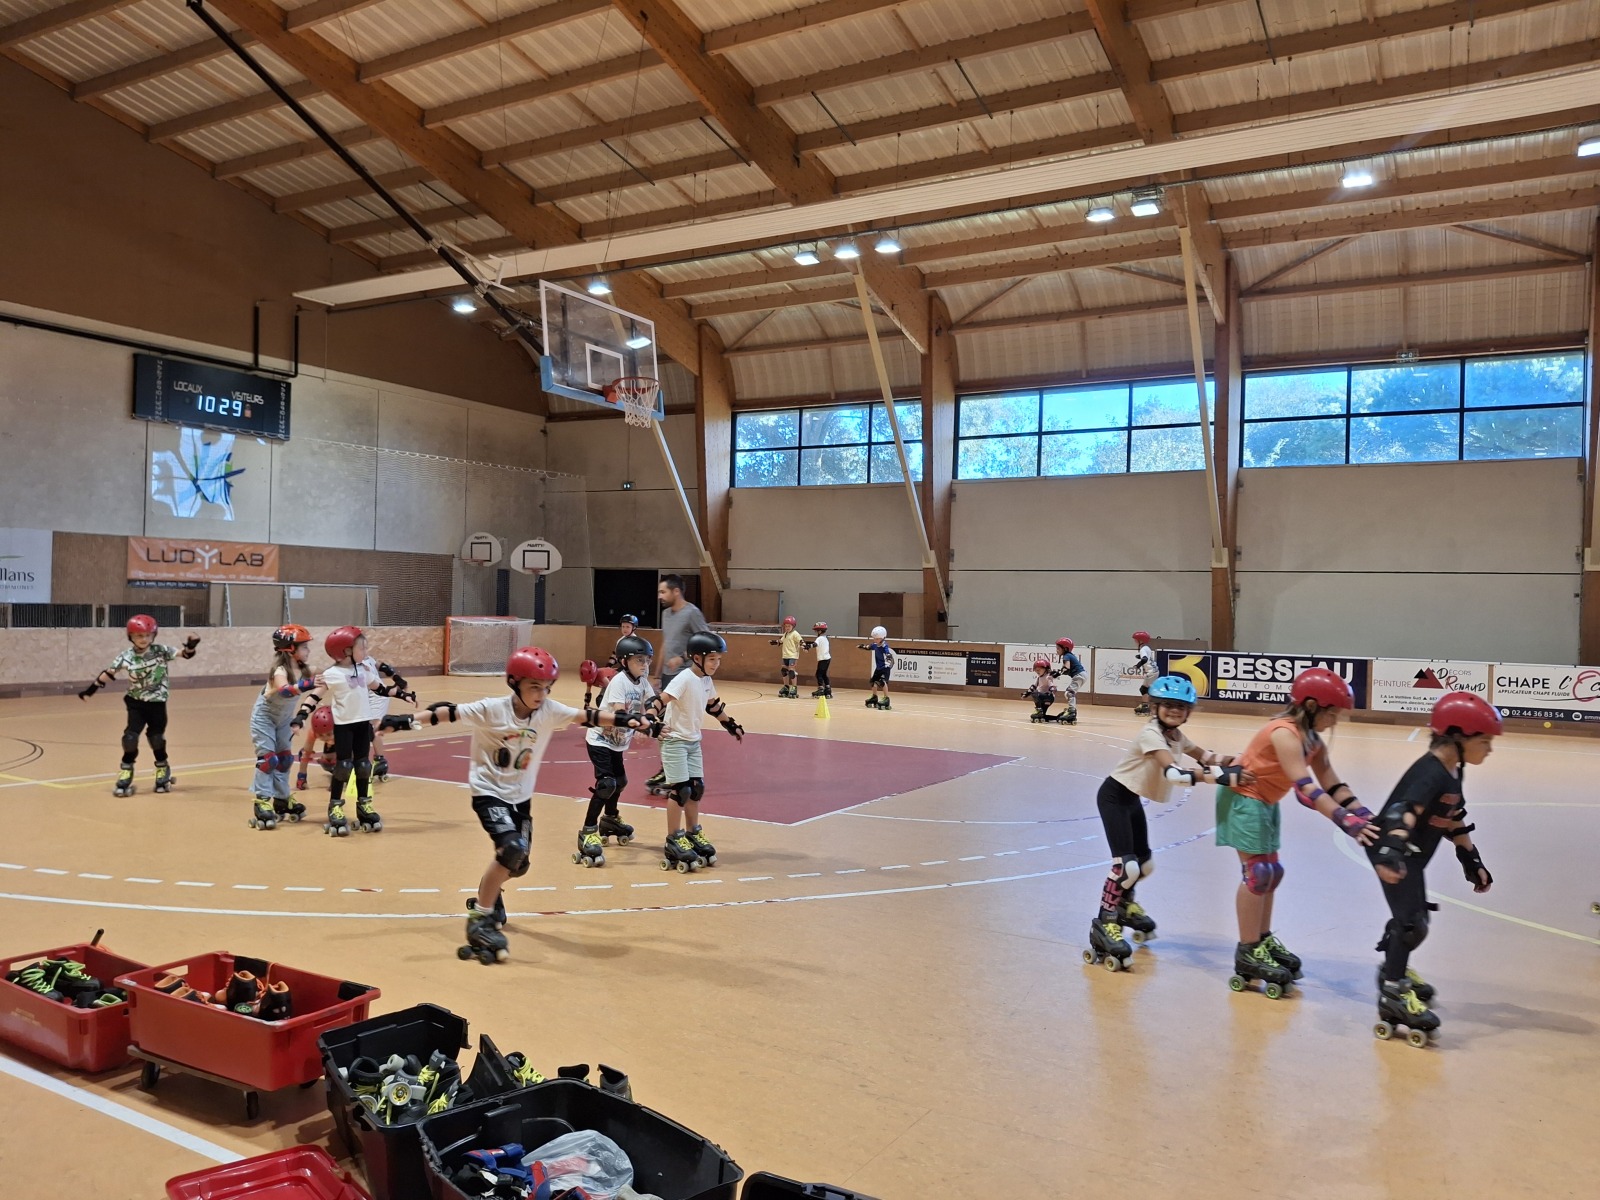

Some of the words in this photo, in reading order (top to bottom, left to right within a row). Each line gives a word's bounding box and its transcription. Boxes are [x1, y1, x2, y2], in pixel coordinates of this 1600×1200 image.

[173, 380, 203, 394] LOCAUX
[231, 391, 264, 405] VISITEURS
[897, 657, 918, 671] Déco
[1373, 679, 1412, 689] PEINTURE
[1496, 676, 1550, 690] CHAPE
[1218, 690, 1251, 700] SAINT
[1256, 692, 1285, 702] JEAN
